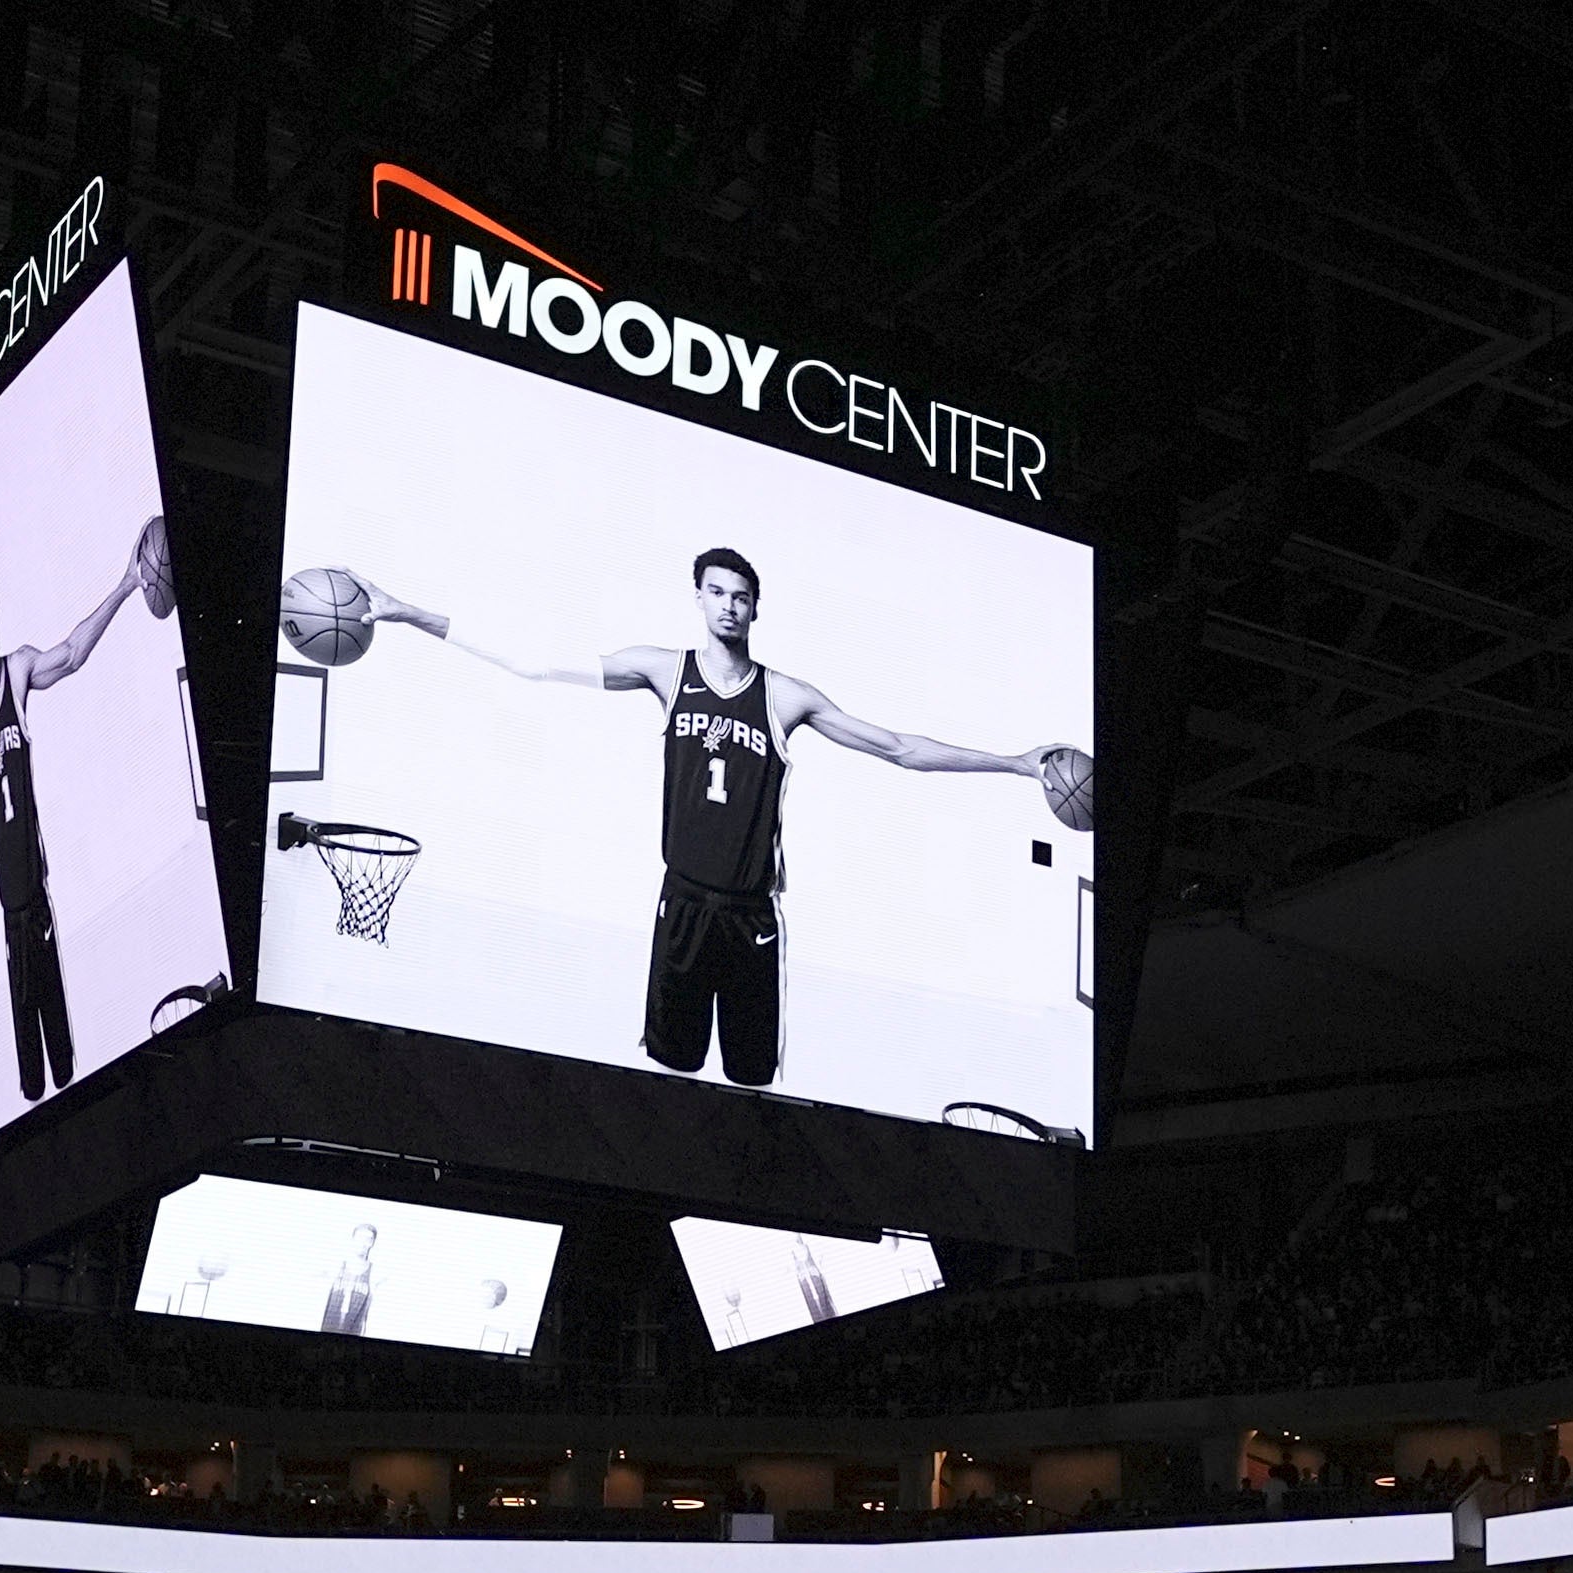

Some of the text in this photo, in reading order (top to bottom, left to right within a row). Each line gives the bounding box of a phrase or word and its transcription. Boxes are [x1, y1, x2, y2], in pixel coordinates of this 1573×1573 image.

[452, 243, 1048, 501] MOODY CENTER
[1, 774, 15, 823] 1
[706, 757, 727, 804] 1
